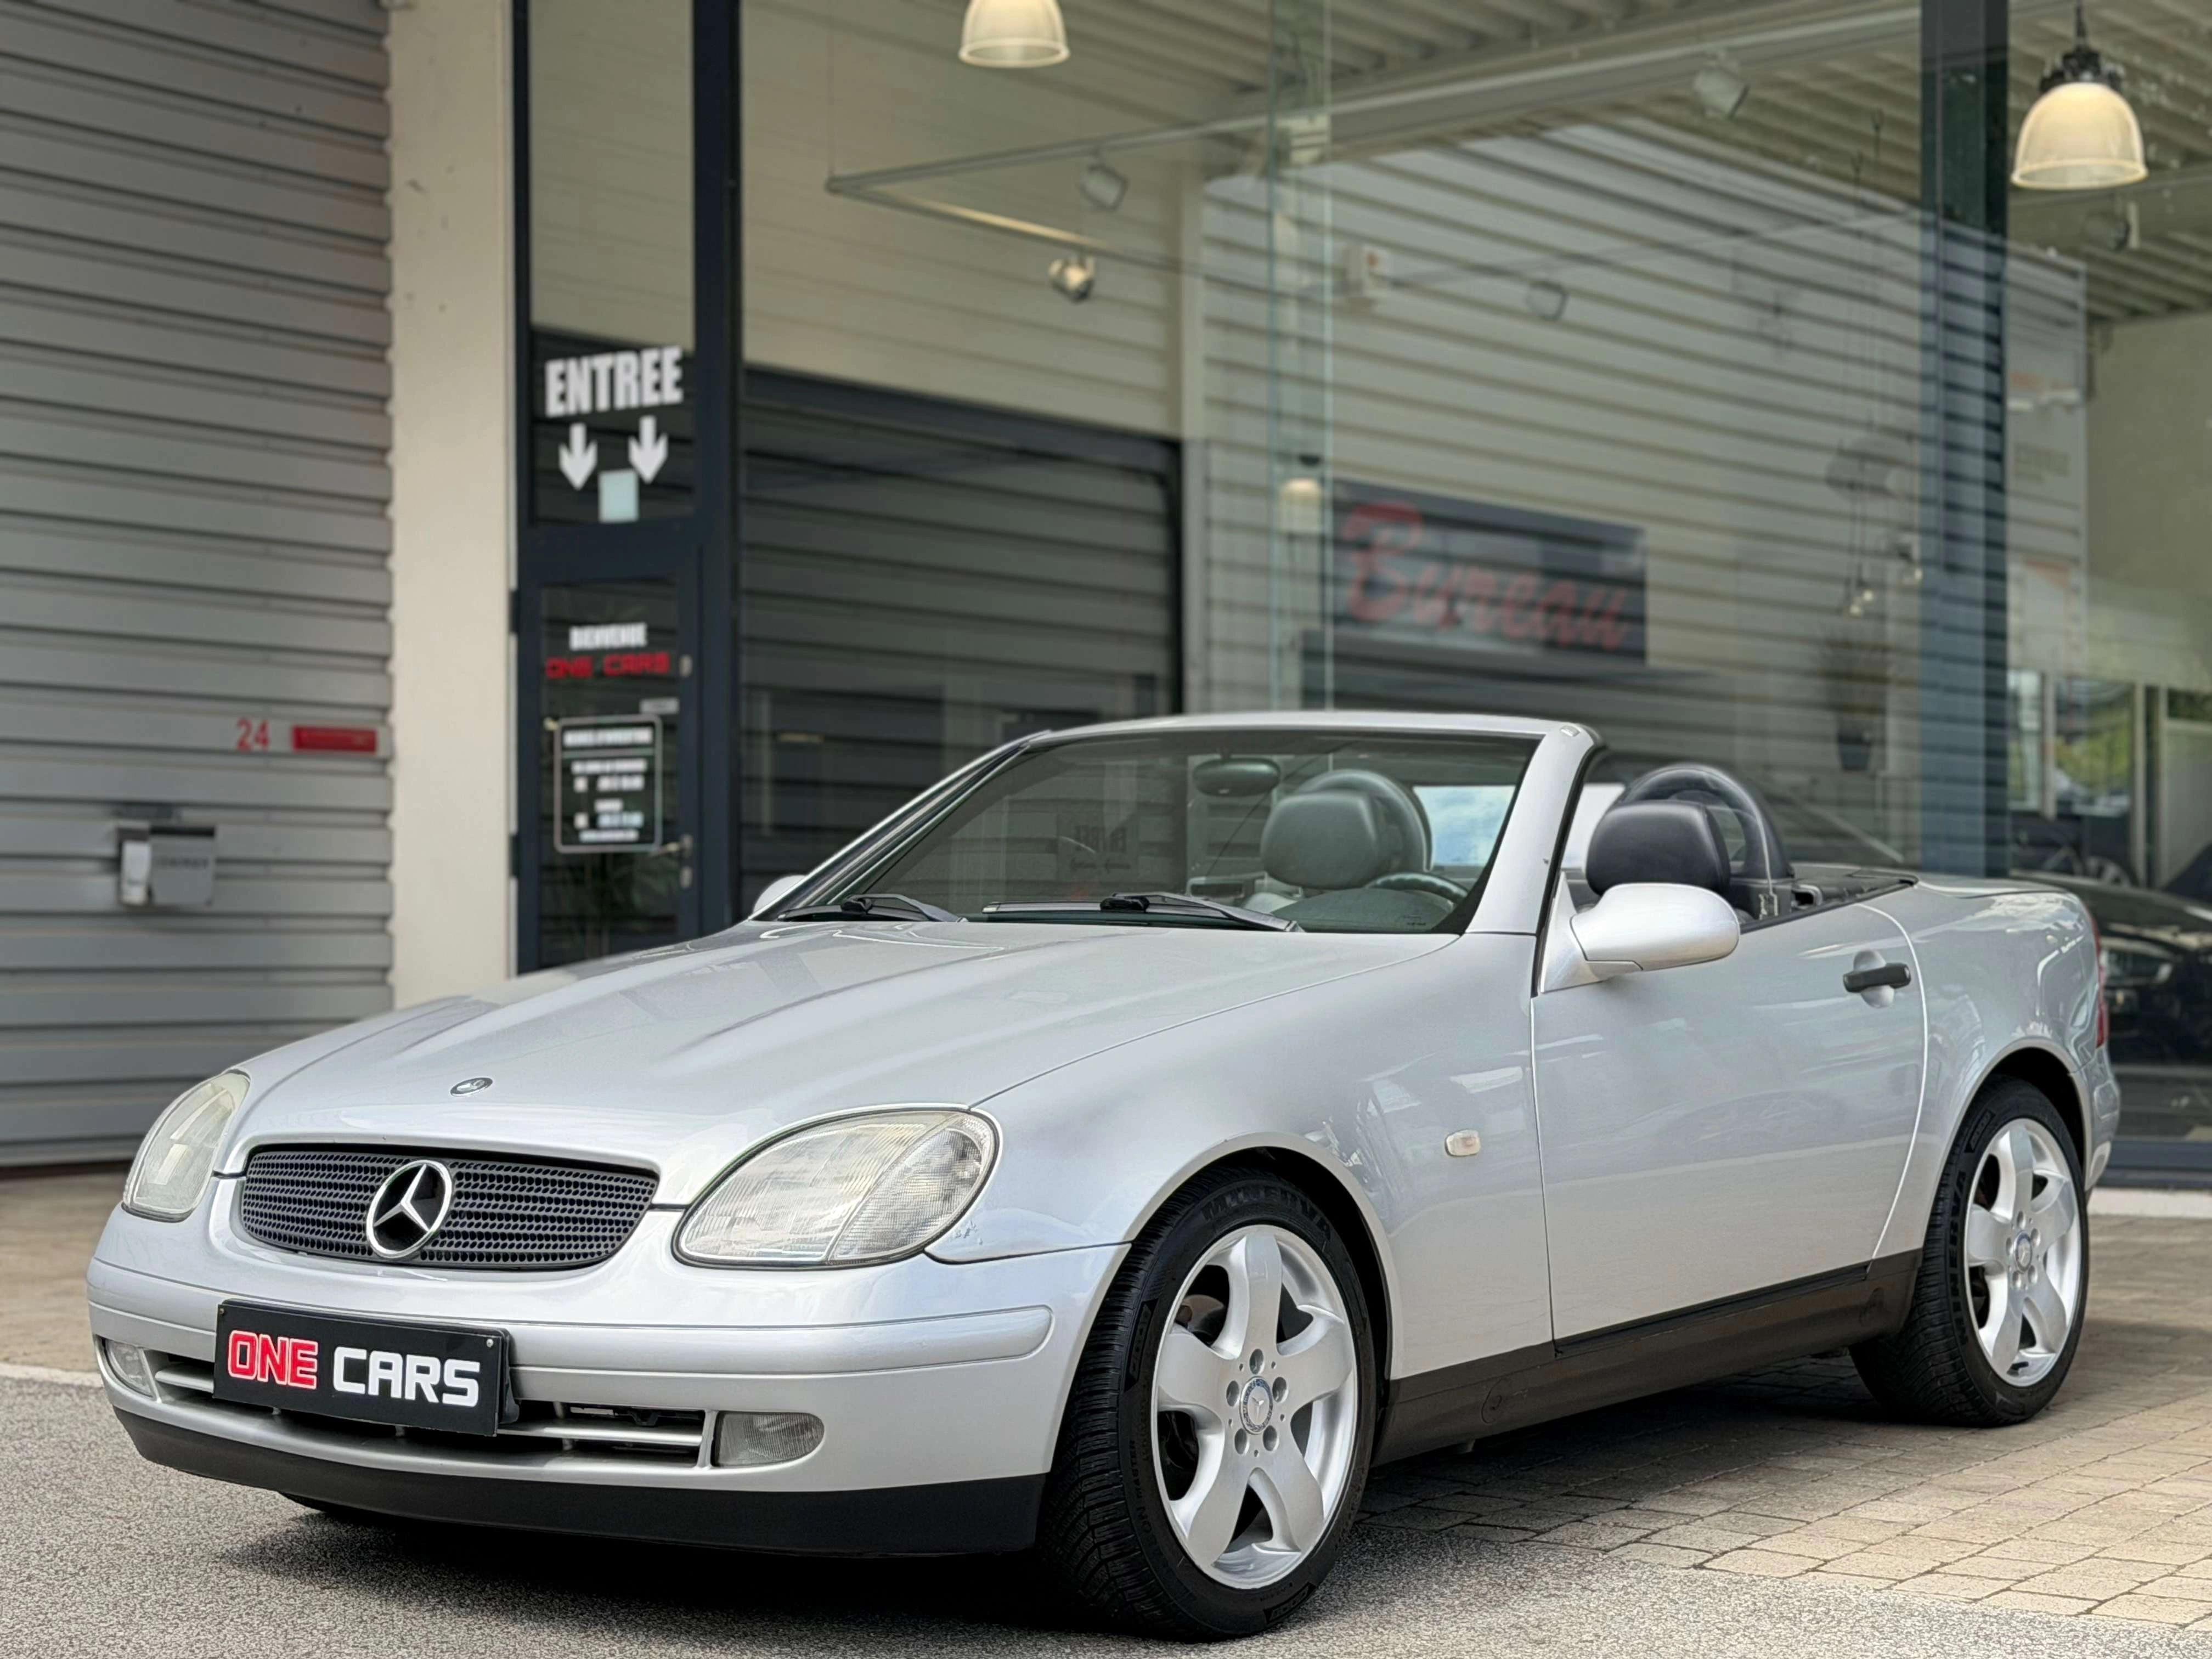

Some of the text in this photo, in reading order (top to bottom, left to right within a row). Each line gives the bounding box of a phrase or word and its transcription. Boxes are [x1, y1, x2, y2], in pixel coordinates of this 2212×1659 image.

[545, 346, 683, 417] ENTREE
[1342, 500, 1630, 650] Bureau
[235, 716, 269, 751] 24
[1948, 1170, 1967, 1345] MINERVA
[227, 1330, 480, 1408] ONE CARS
